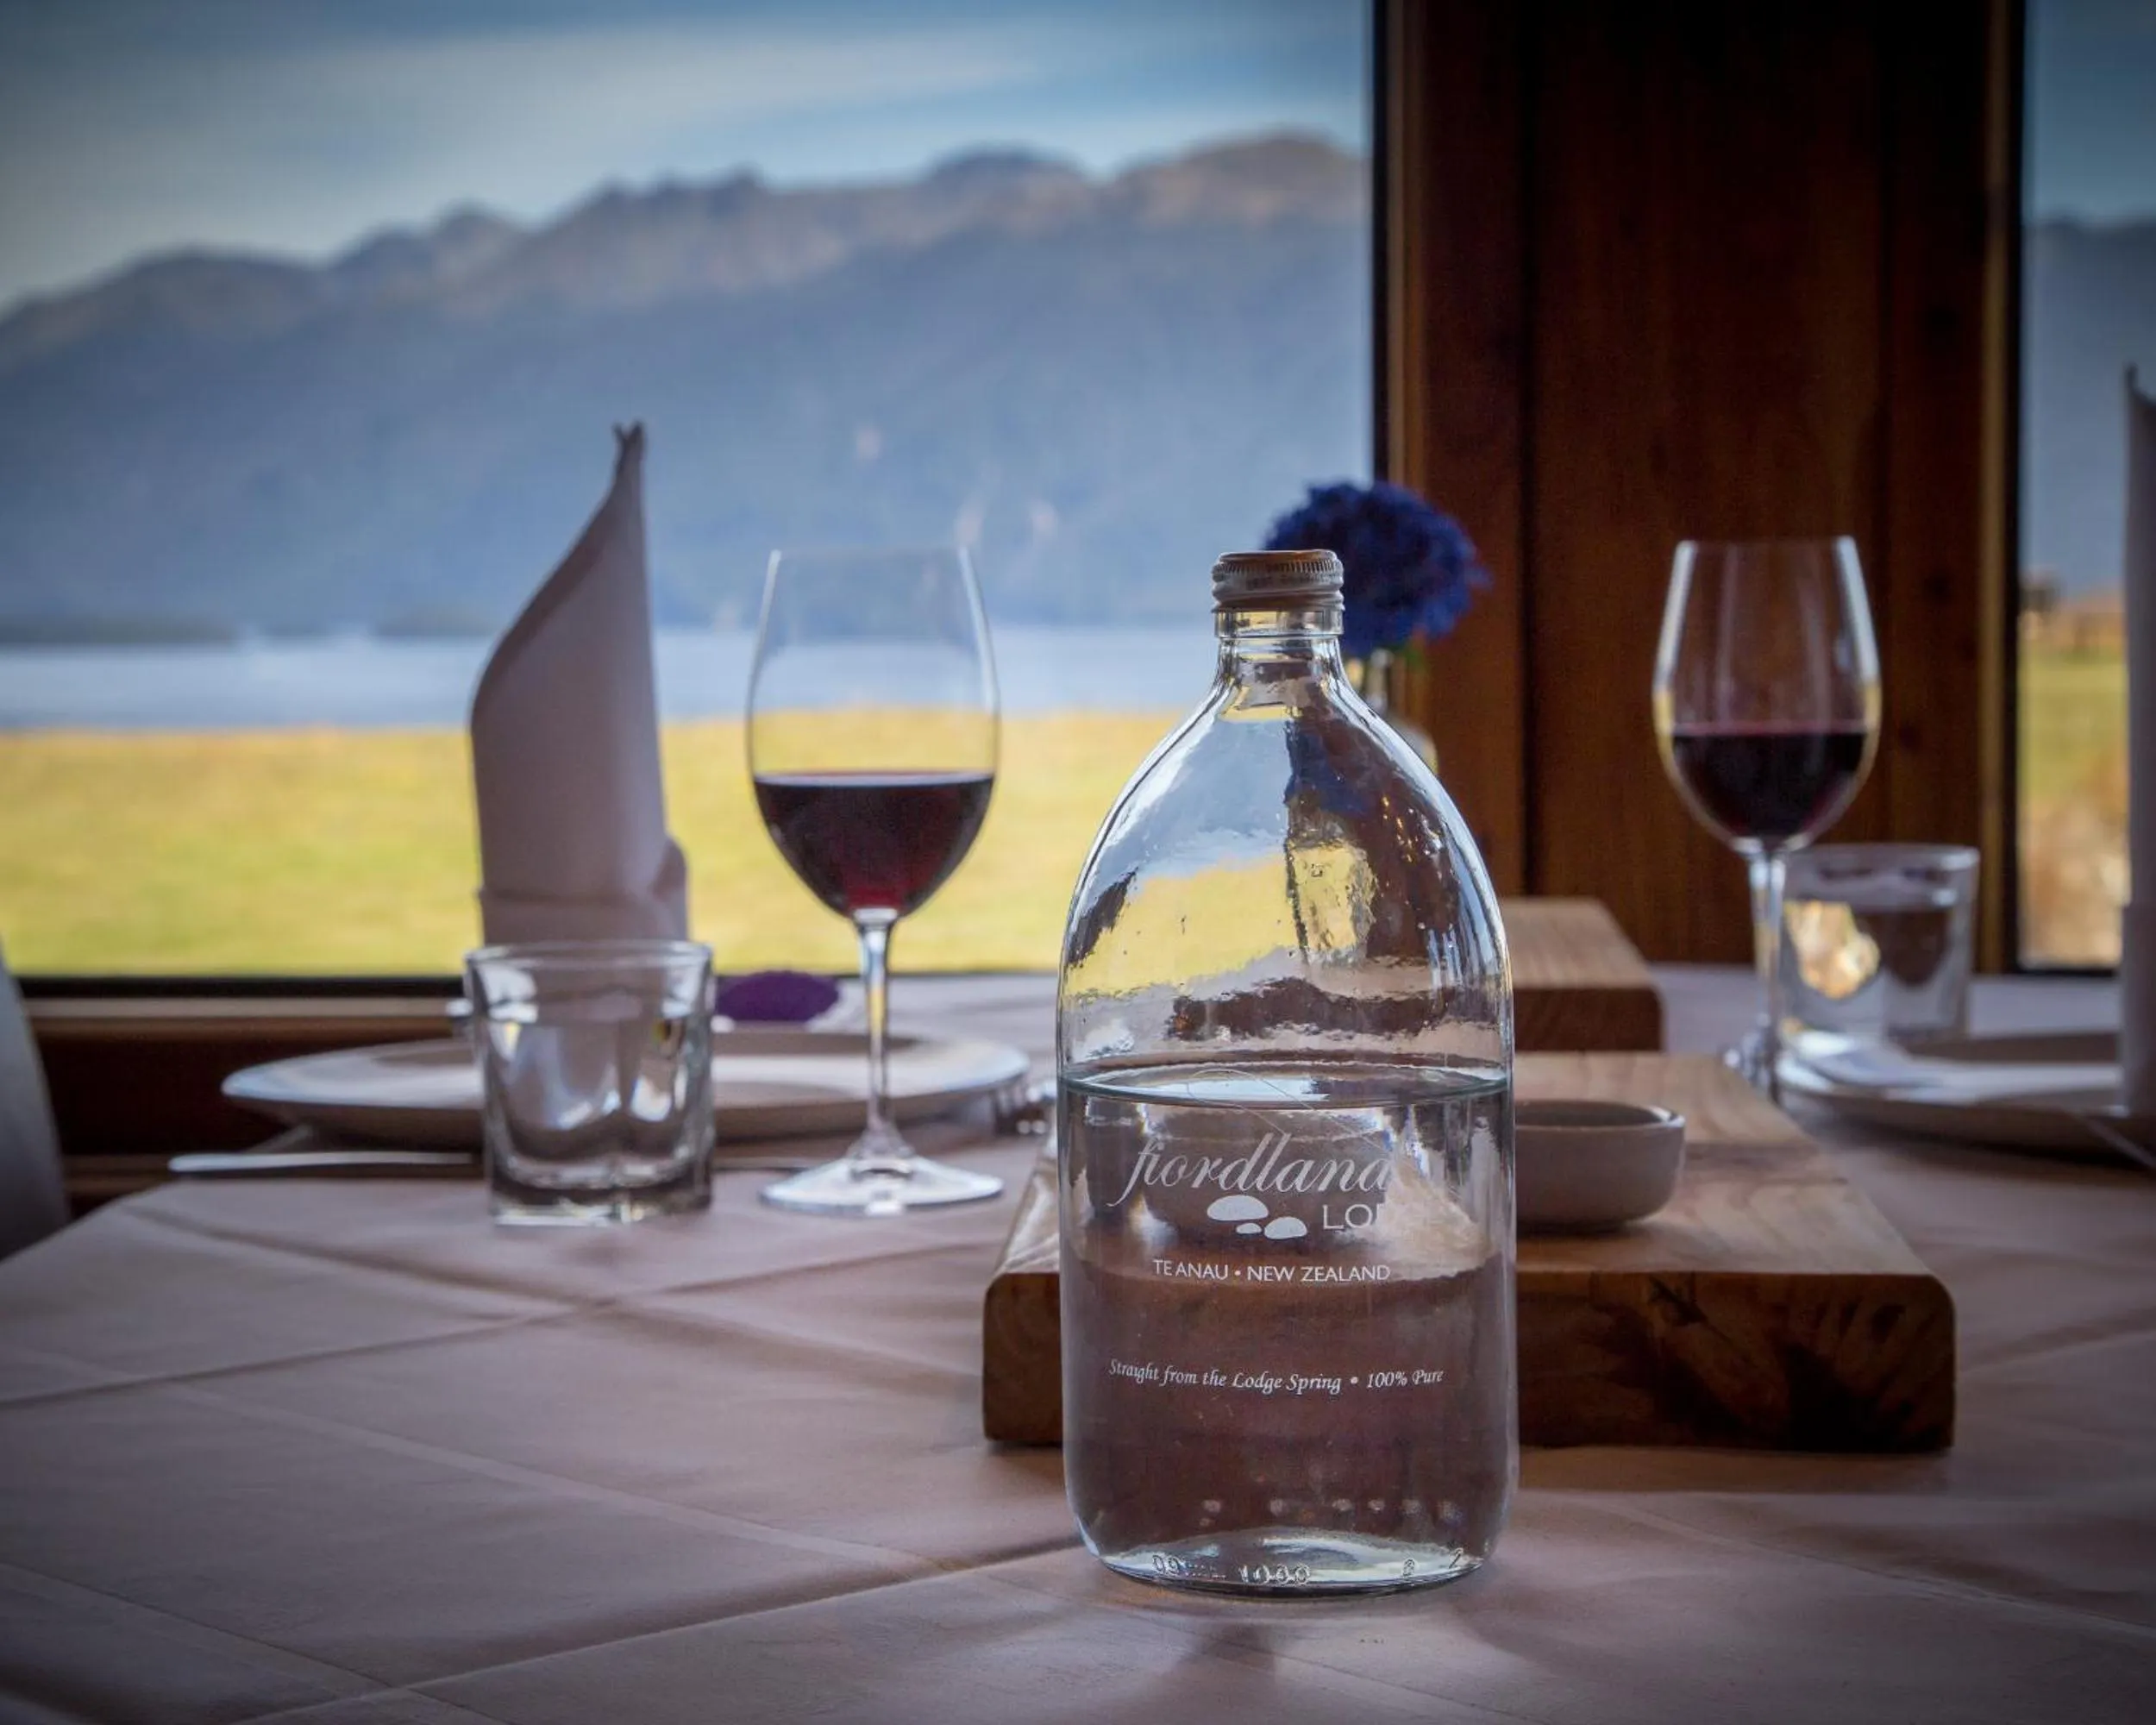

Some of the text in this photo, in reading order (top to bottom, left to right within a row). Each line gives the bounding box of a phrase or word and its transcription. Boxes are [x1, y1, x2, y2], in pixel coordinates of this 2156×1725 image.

[1247, 1265, 1294, 1282] NEW
[1300, 1264, 1391, 1283] ZEALAND
[1109, 1358, 1445, 1396] Straight from the Lodge Spring 100% Pure
